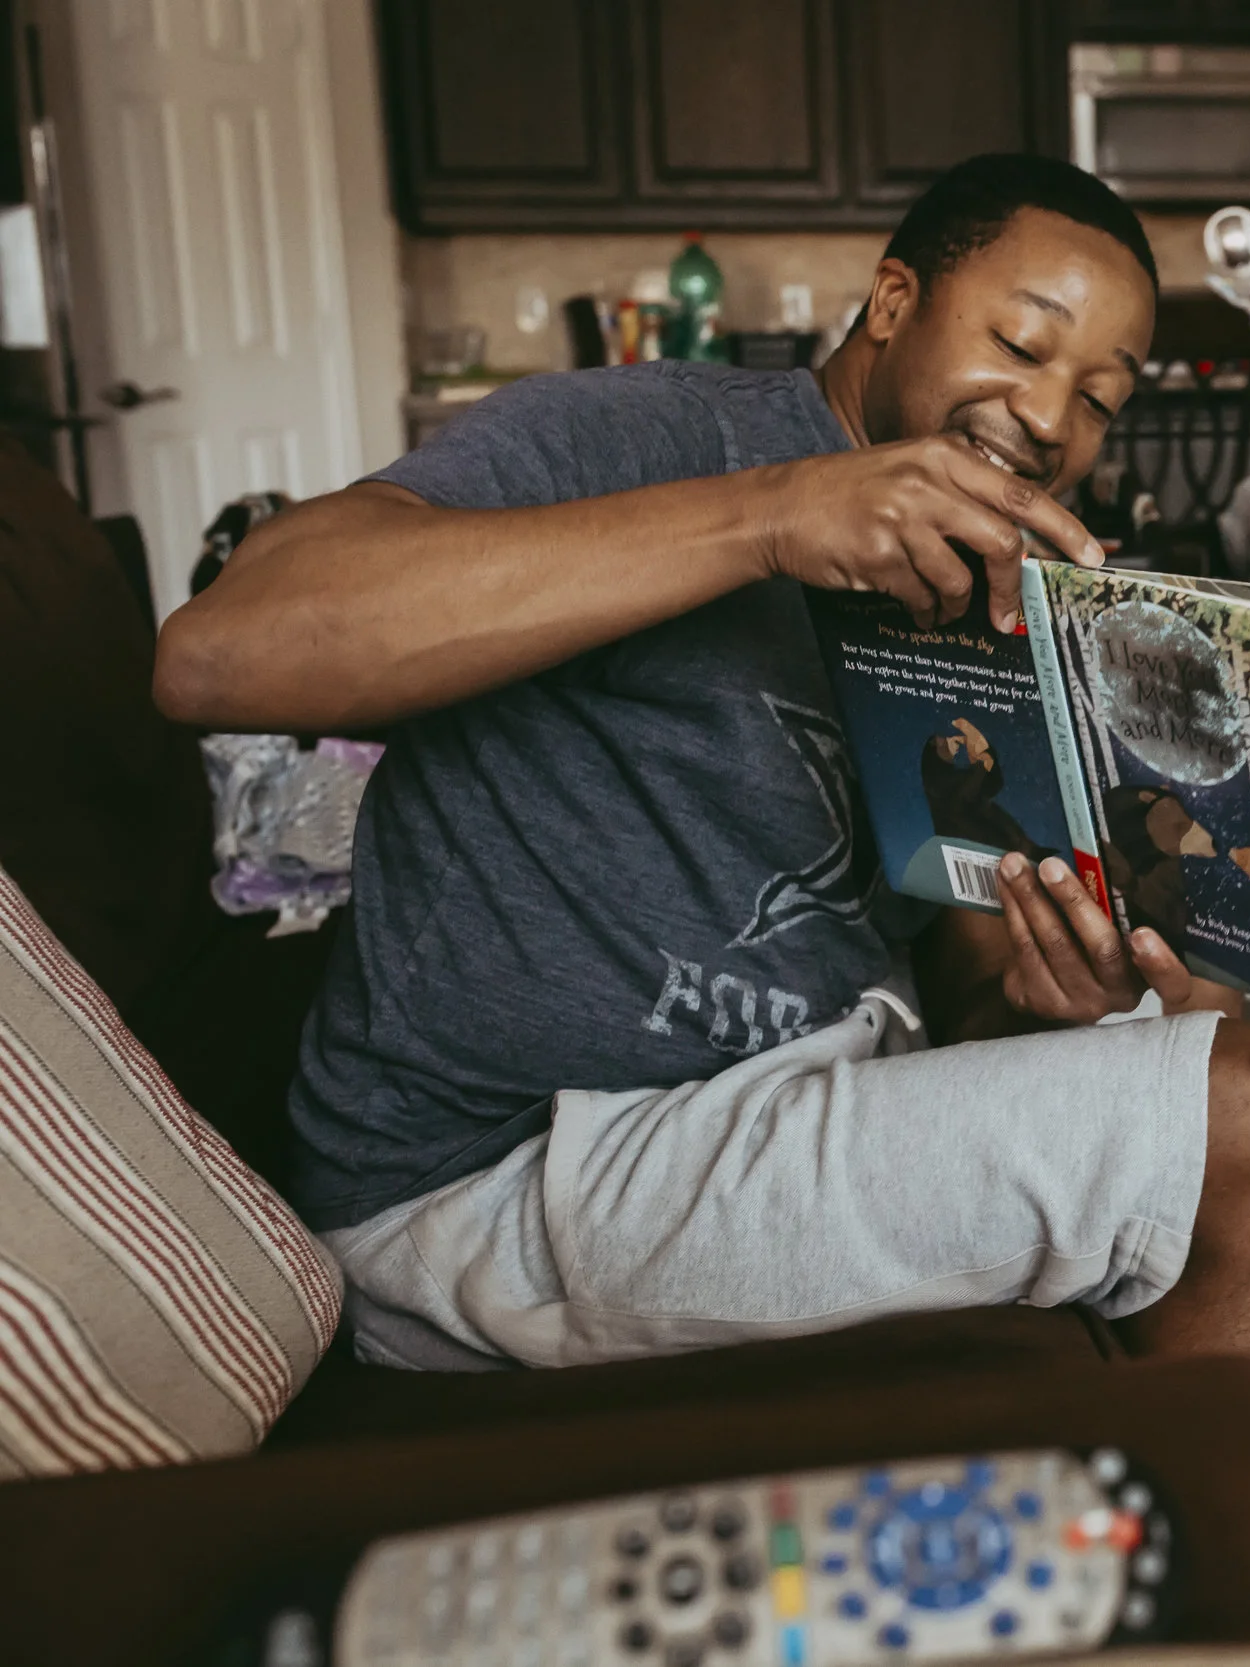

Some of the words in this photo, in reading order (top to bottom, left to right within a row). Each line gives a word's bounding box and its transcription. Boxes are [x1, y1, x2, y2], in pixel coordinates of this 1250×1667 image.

[909, 631, 944, 646] sparkle
[946, 632, 956, 643] in
[958, 633, 974, 647] the
[1104, 638, 1116, 665] I
[841, 641, 858, 654] Bear
[859, 645, 878, 658] loves
[894, 653, 913, 664] more
[915, 654, 932, 666] than
[998, 669, 1012, 680] and
[845, 659, 855, 671] As
[857, 661, 872, 675] they
[874, 666, 900, 678] explore
[901, 668, 914, 680] the
[915, 673, 936, 684] world
[970, 679, 992, 695] Bear's
[994, 684, 1010, 697] love
[1011, 687, 1024, 699] for
[920, 688, 933, 699] and
[973, 697, 987, 708] and
[1121, 713, 1163, 741] and
